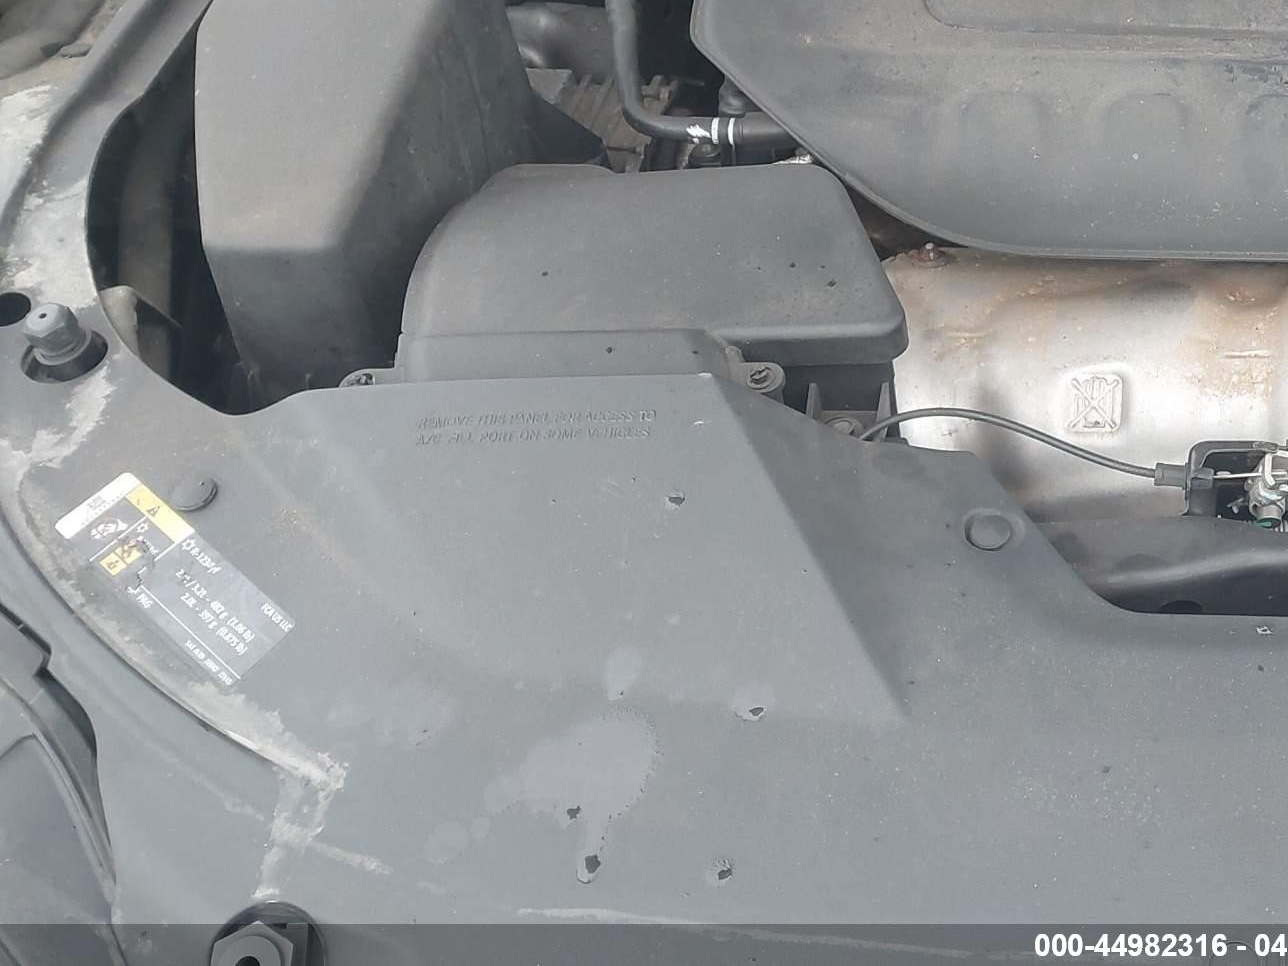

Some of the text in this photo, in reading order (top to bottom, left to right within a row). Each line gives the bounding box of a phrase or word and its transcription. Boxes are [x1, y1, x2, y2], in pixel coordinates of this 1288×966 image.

[477, 413, 506, 427] THIS
[584, 409, 636, 423] ACCESS
[639, 408, 657, 422] TO
[585, 425, 651, 440] VEHICLES
[260, 604, 294, 632] FCA US LLC
